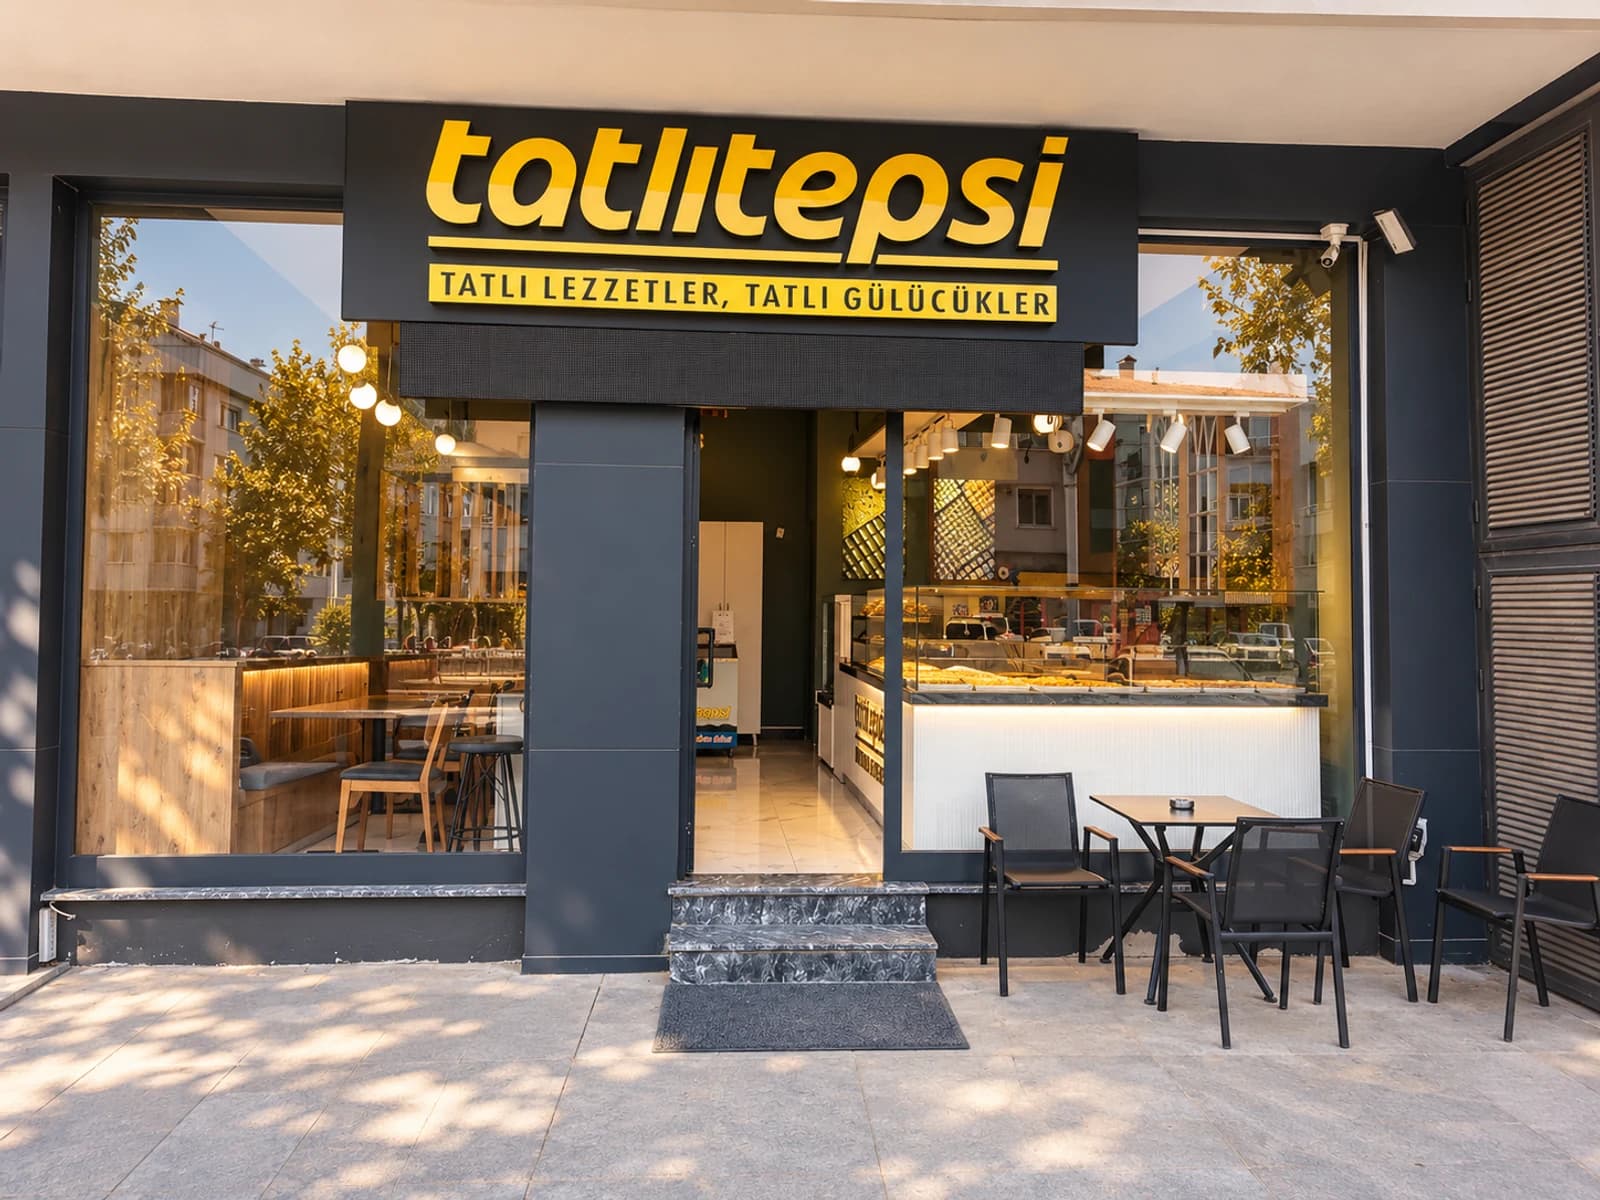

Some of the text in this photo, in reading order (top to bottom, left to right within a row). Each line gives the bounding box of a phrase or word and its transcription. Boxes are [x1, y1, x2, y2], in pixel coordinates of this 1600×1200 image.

[425, 119, 1069, 265] tatlıtepsi
[440, 271, 1050, 315] TATLI LEZZETLER, TATLI GÜLÜCÜKLER
